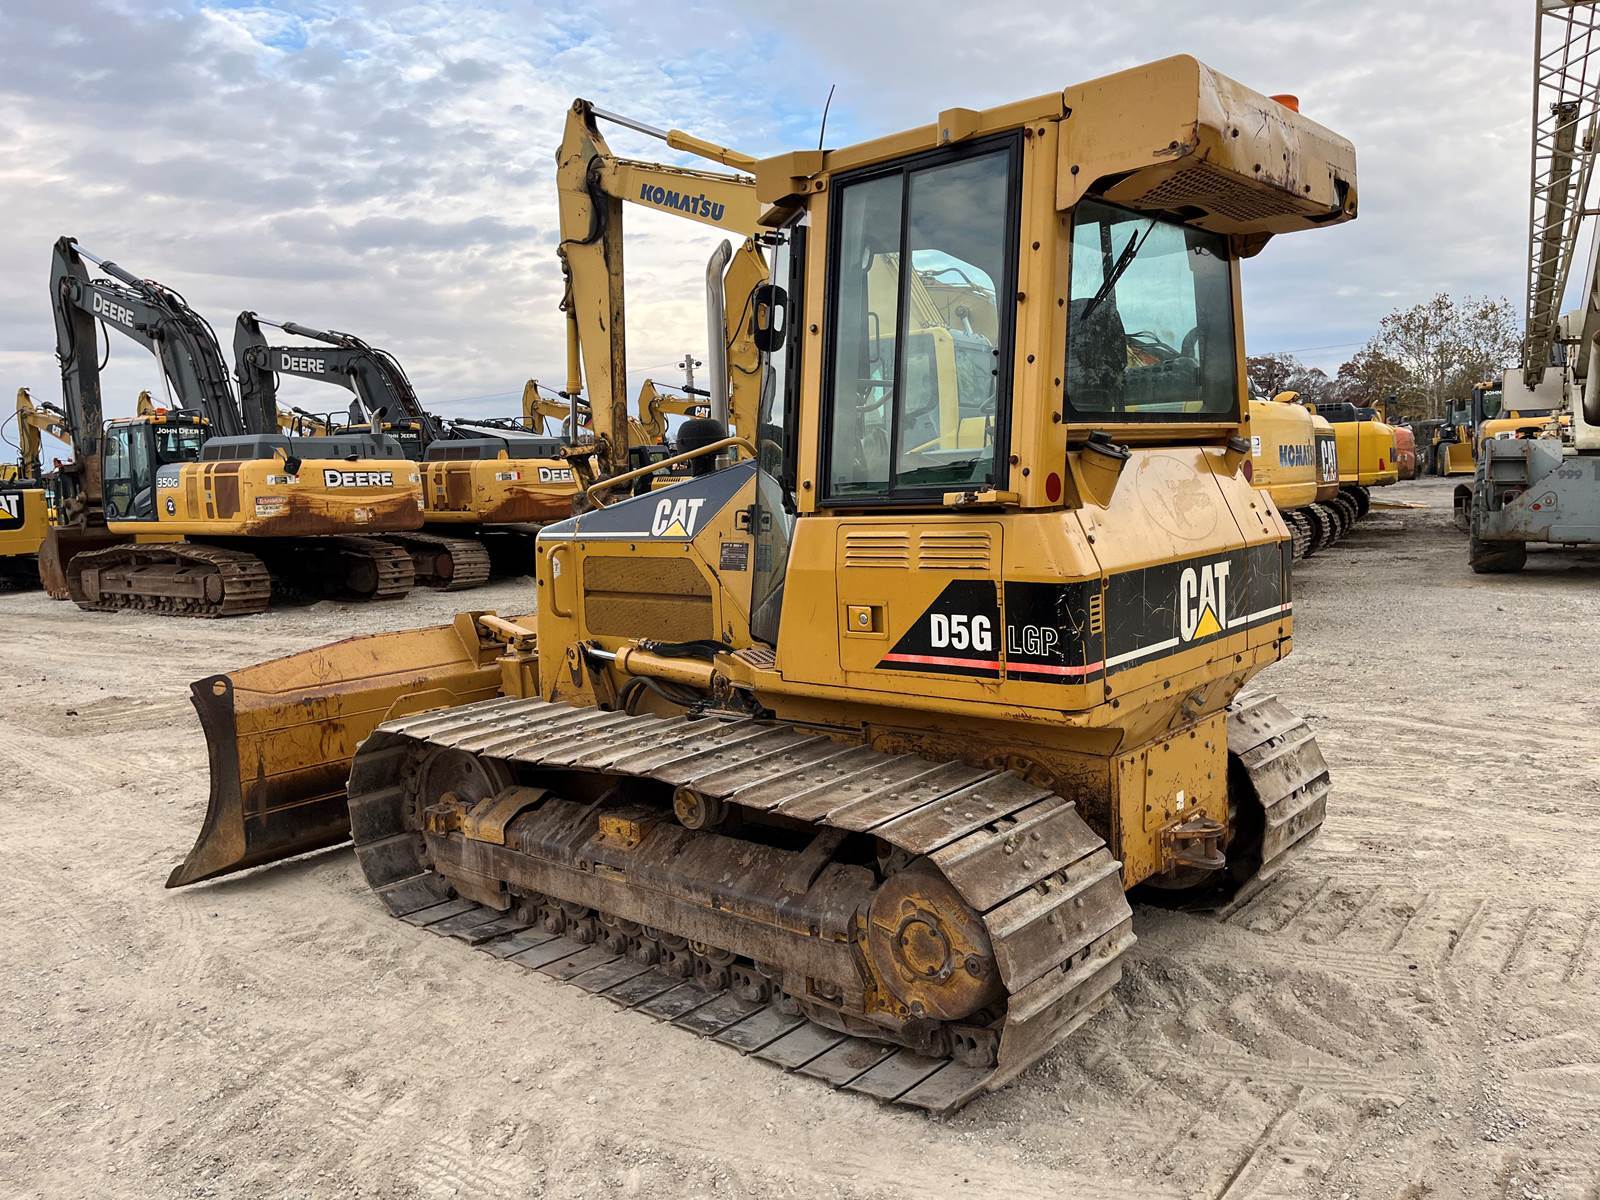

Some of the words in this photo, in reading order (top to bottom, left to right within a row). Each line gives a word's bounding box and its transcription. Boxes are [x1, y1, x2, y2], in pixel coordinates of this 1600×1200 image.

[640, 183, 725, 221] KOMATSU
[93, 292, 134, 327] DEERE
[281, 353, 325, 374] DEERE
[577, 413, 587, 426] AT
[695, 406, 710, 418] CAT
[324, 465, 393, 488] DEERE
[1320, 440, 1338, 482] CAT
[157, 477, 178, 487] 350G
[651, 498, 704, 537] CAT
[1180, 560, 1231, 642] CAT
[930, 613, 993, 652] D5G
[1007, 625, 1059, 656] LGP
